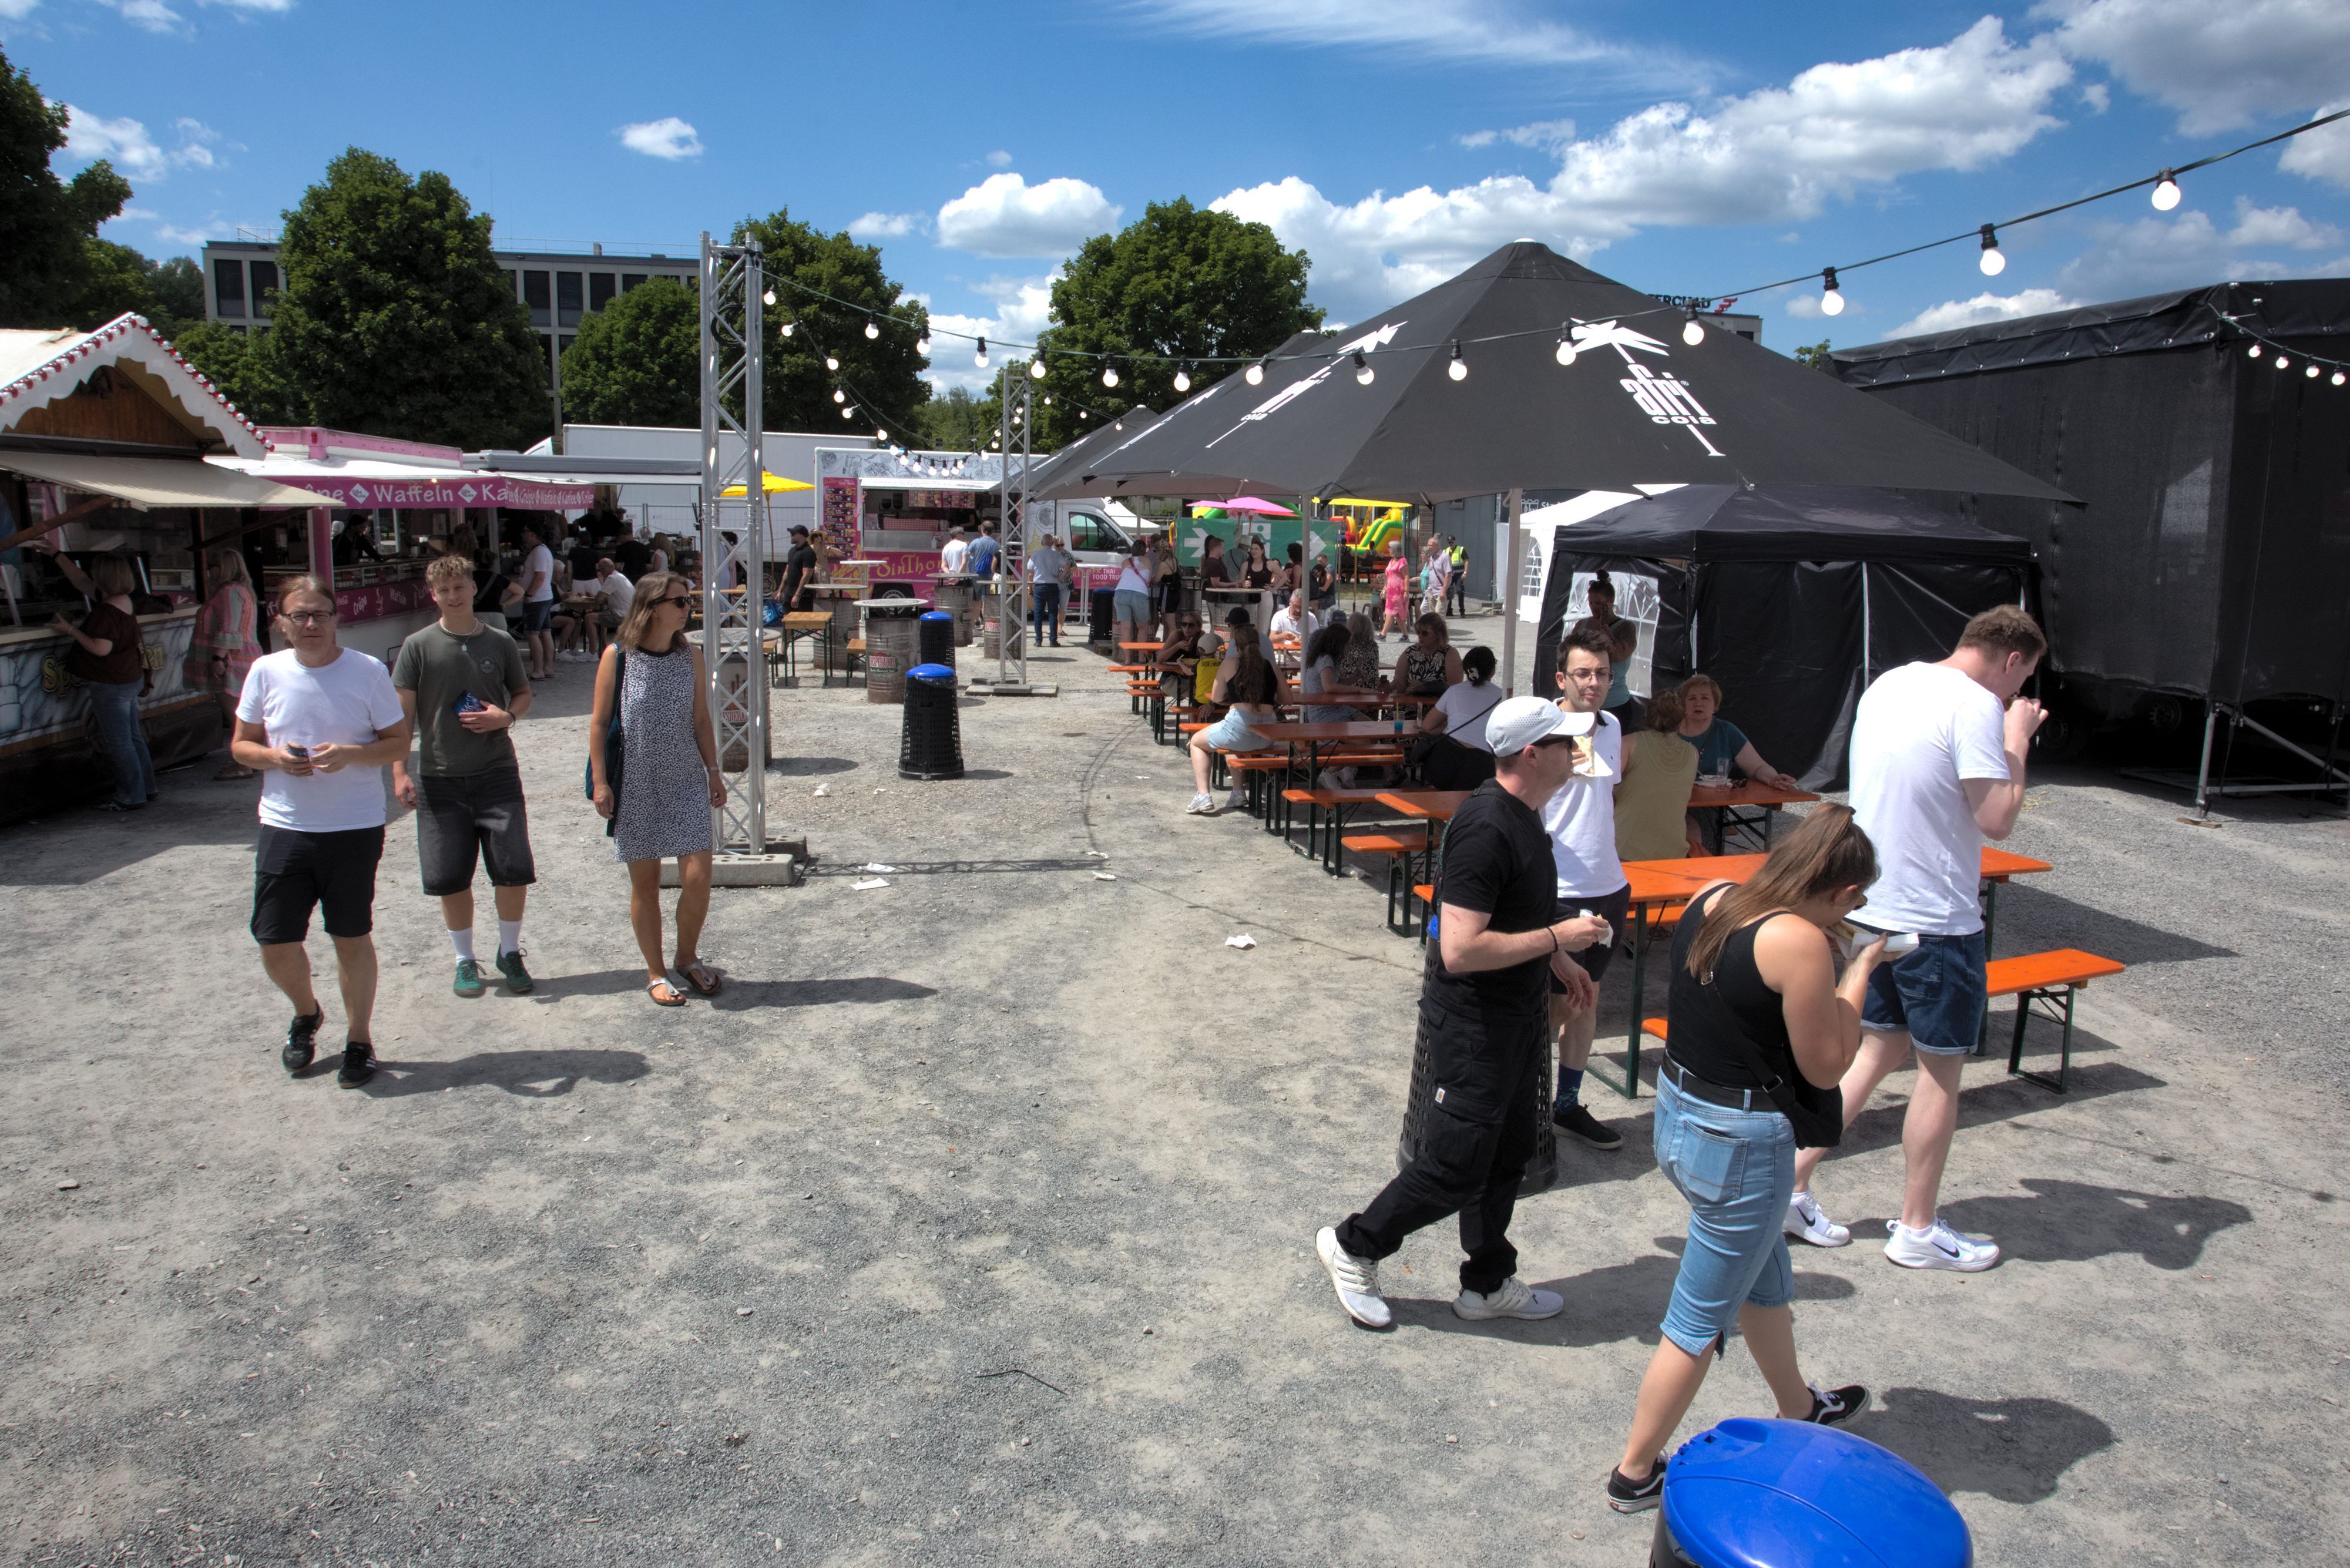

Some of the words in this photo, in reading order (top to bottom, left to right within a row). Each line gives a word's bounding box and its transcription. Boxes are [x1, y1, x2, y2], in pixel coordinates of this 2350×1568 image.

[1651, 416, 1717, 425] cola
[374, 485, 454, 503] Waffeln
[870, 656, 896, 668] DESPERADOS
